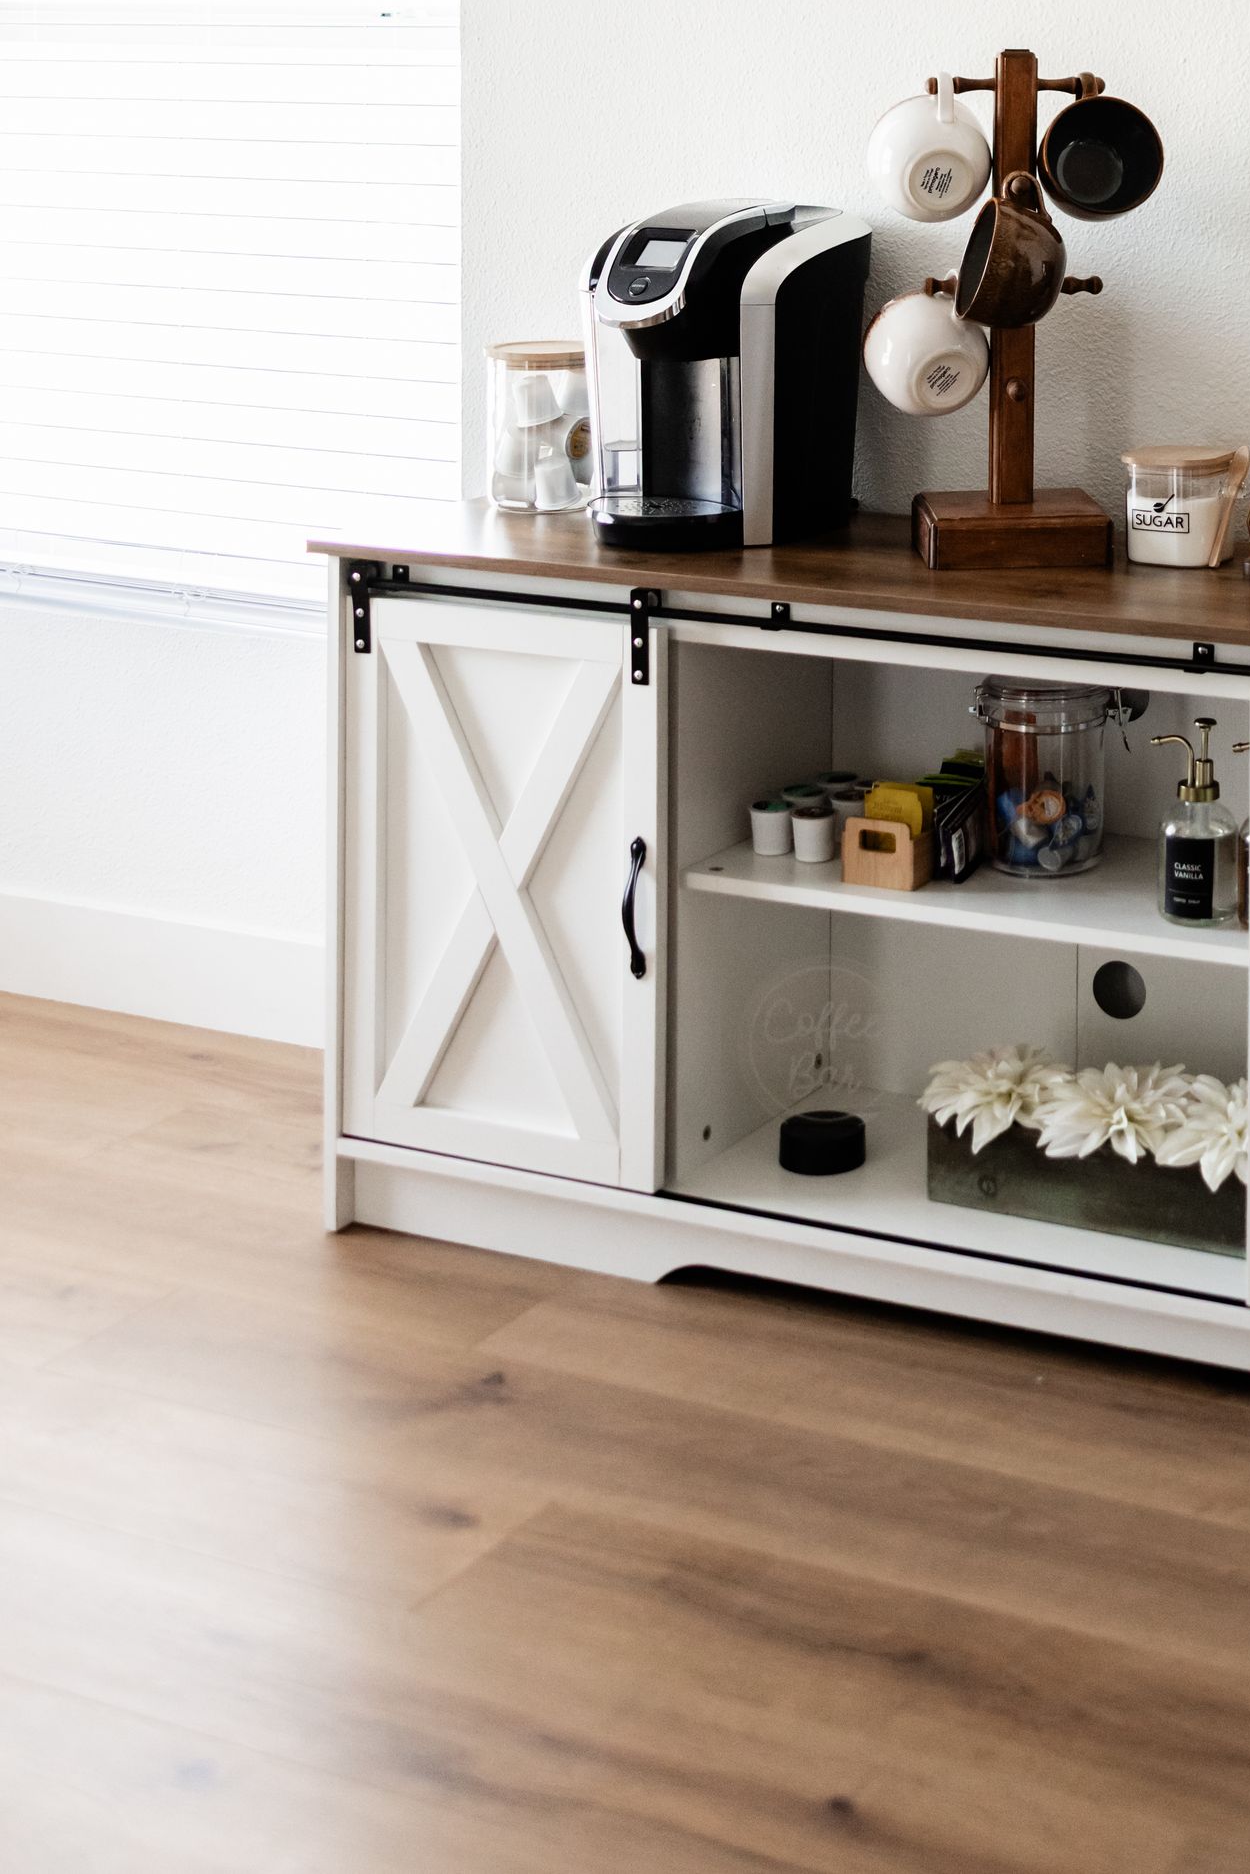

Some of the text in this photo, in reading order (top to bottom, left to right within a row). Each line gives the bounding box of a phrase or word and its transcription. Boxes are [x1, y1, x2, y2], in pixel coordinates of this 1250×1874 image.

[1135, 513, 1184, 529] SUGAR
[1174, 862, 1202, 872] CLASSIC
[1174, 870, 1204, 880] VANILLA
